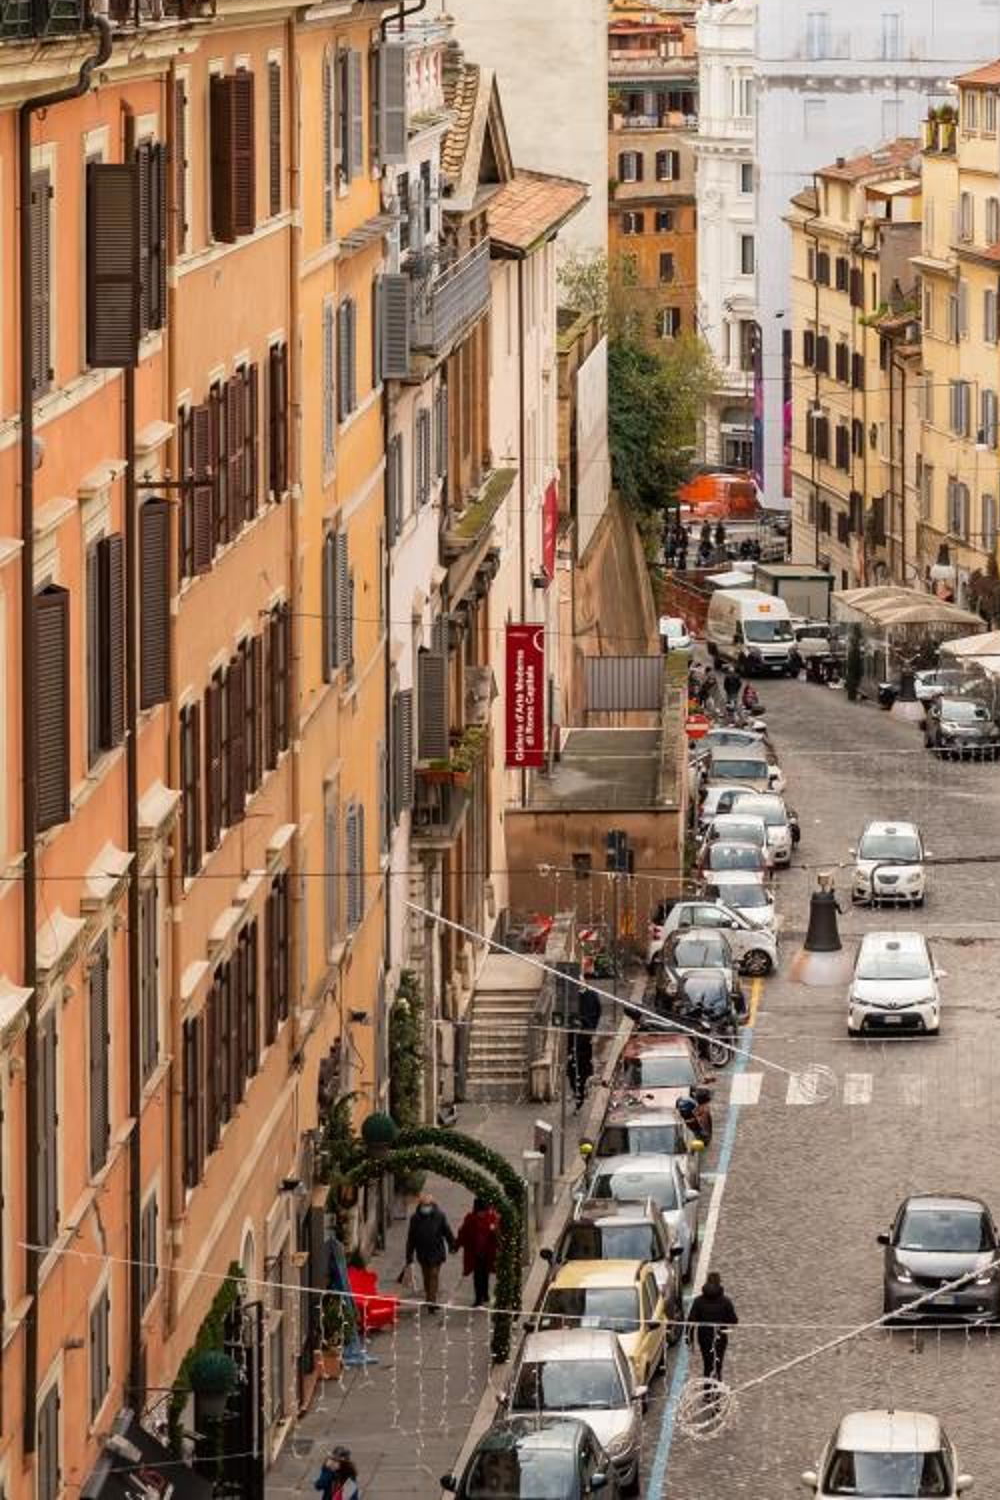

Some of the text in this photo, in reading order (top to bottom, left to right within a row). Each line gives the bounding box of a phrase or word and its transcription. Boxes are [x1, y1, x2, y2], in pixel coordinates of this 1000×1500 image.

[515, 649, 525, 761] Galleria d'Arte Moderna
[525, 665, 536, 705] Capitale
[525, 706, 535, 734] Roma
